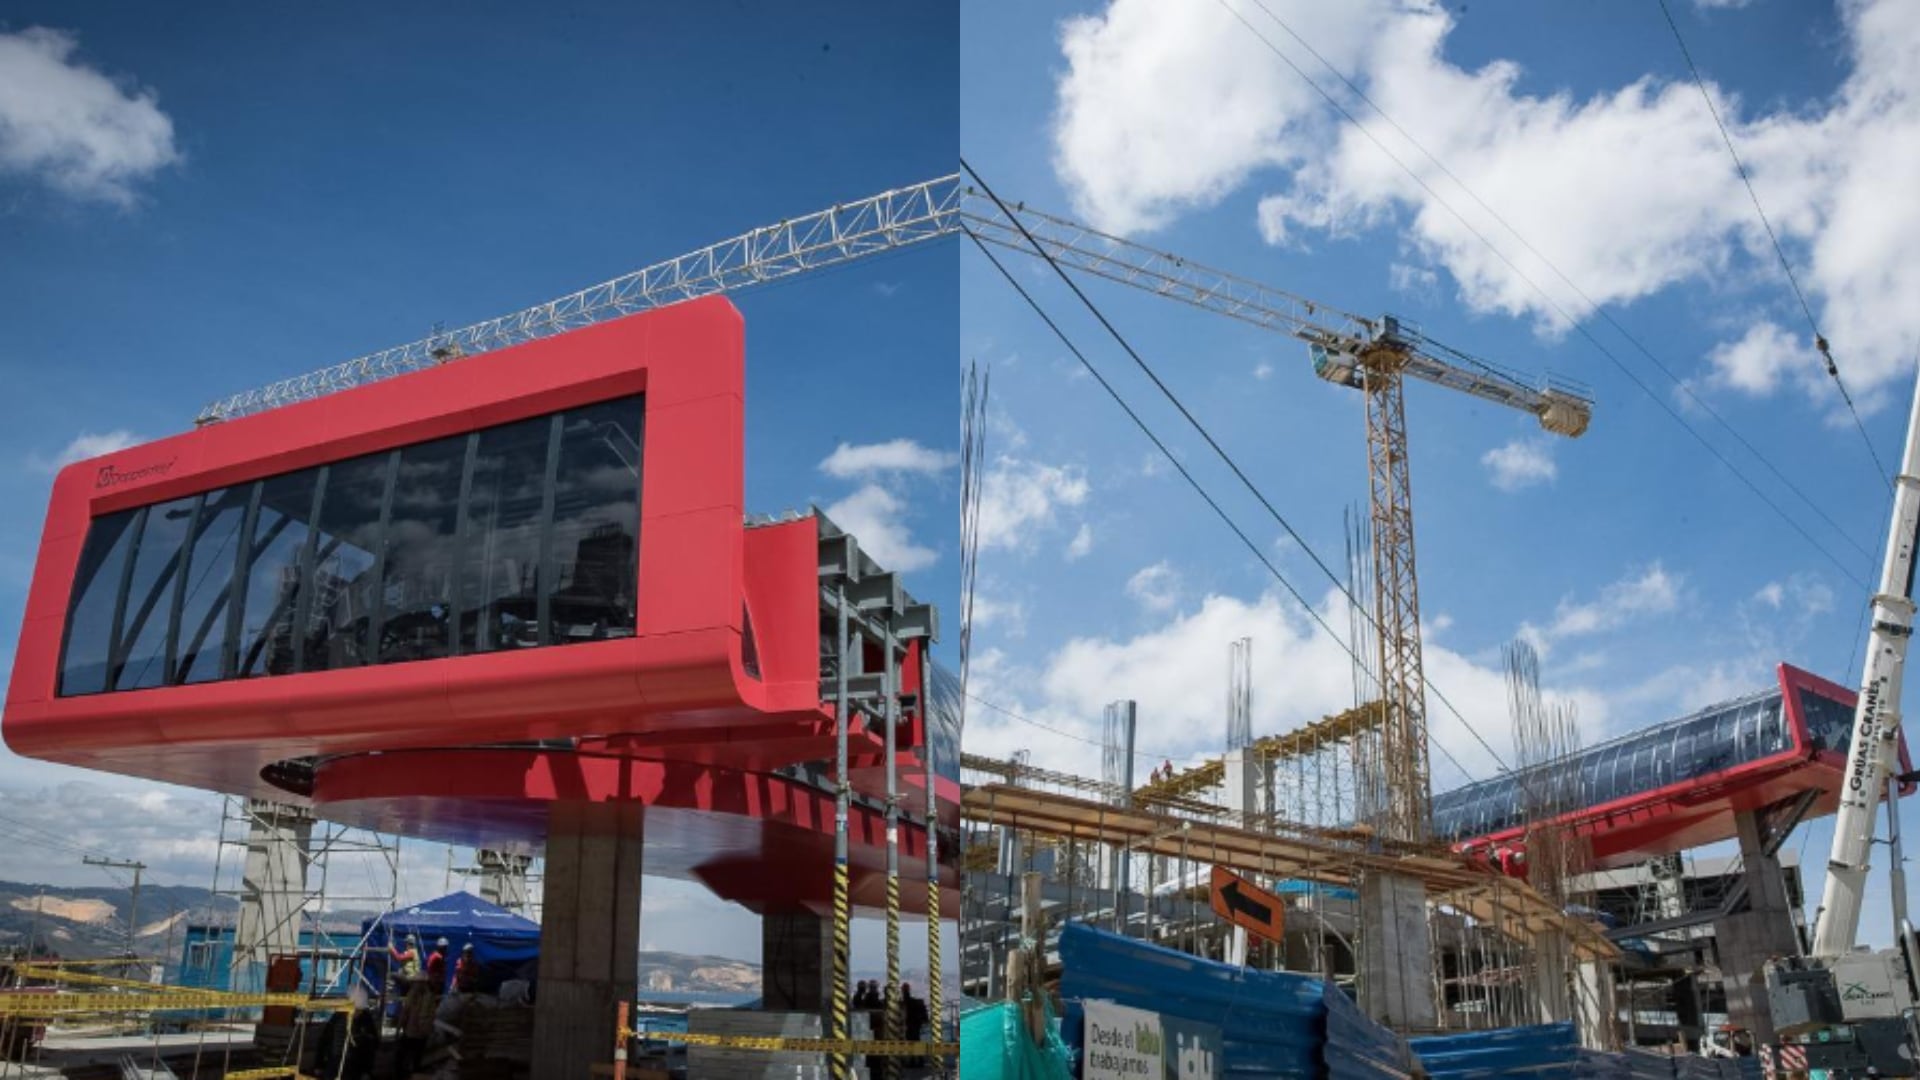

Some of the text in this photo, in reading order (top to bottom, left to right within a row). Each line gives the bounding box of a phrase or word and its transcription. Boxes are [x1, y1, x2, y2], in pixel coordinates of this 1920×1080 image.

[1091, 1022, 1124, 1048] Desde
[1125, 1030, 1134, 1049] el
[1090, 1050, 1149, 1076] trabajamos
